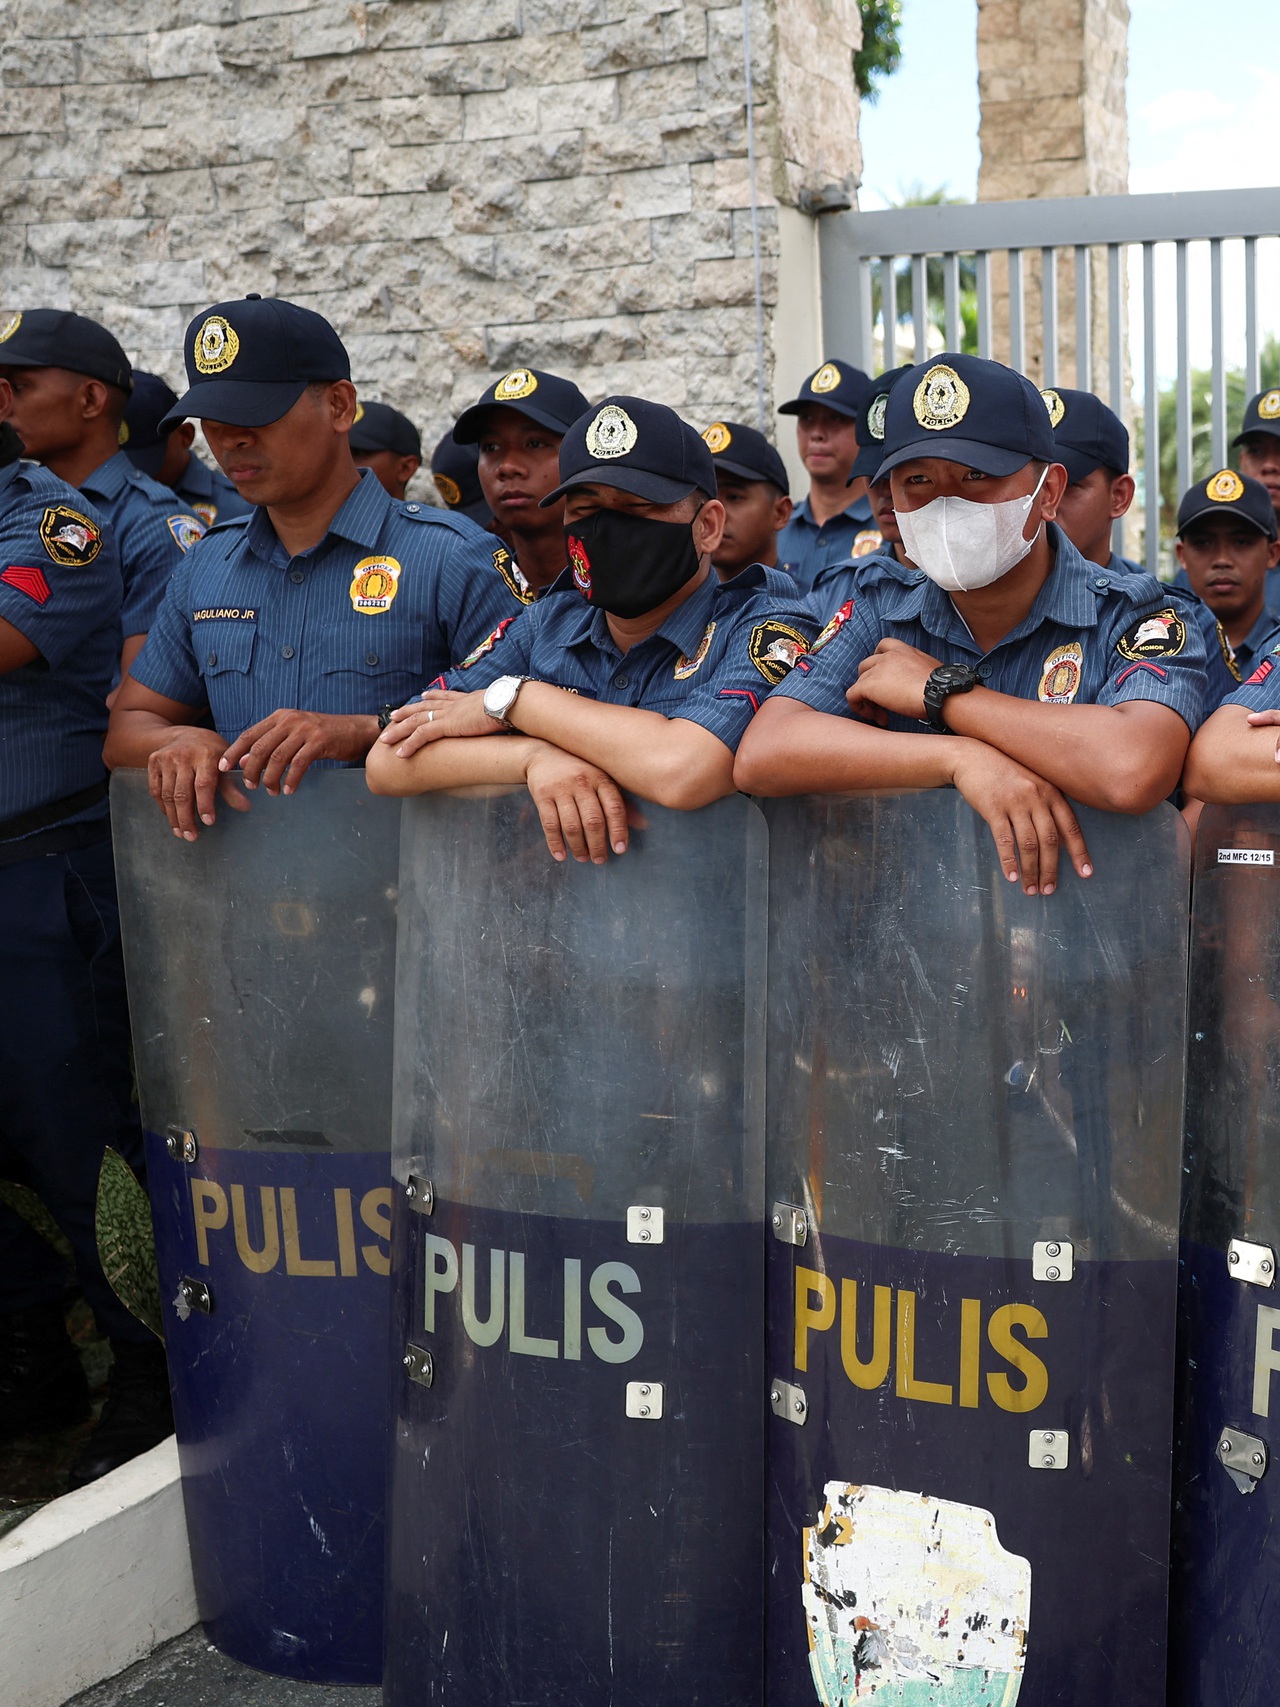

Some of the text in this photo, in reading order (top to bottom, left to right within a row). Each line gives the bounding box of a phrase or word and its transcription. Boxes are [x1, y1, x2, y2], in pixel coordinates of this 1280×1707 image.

[924, 413, 958, 426] POLICE
[241, 609, 254, 619] JR
[766, 660, 787, 675] HONOR
[1219, 852, 1271, 862] 2nd MFC 12/15
[425, 1233, 644, 1364] PULIS
[793, 1267, 1049, 1413] PULIS
